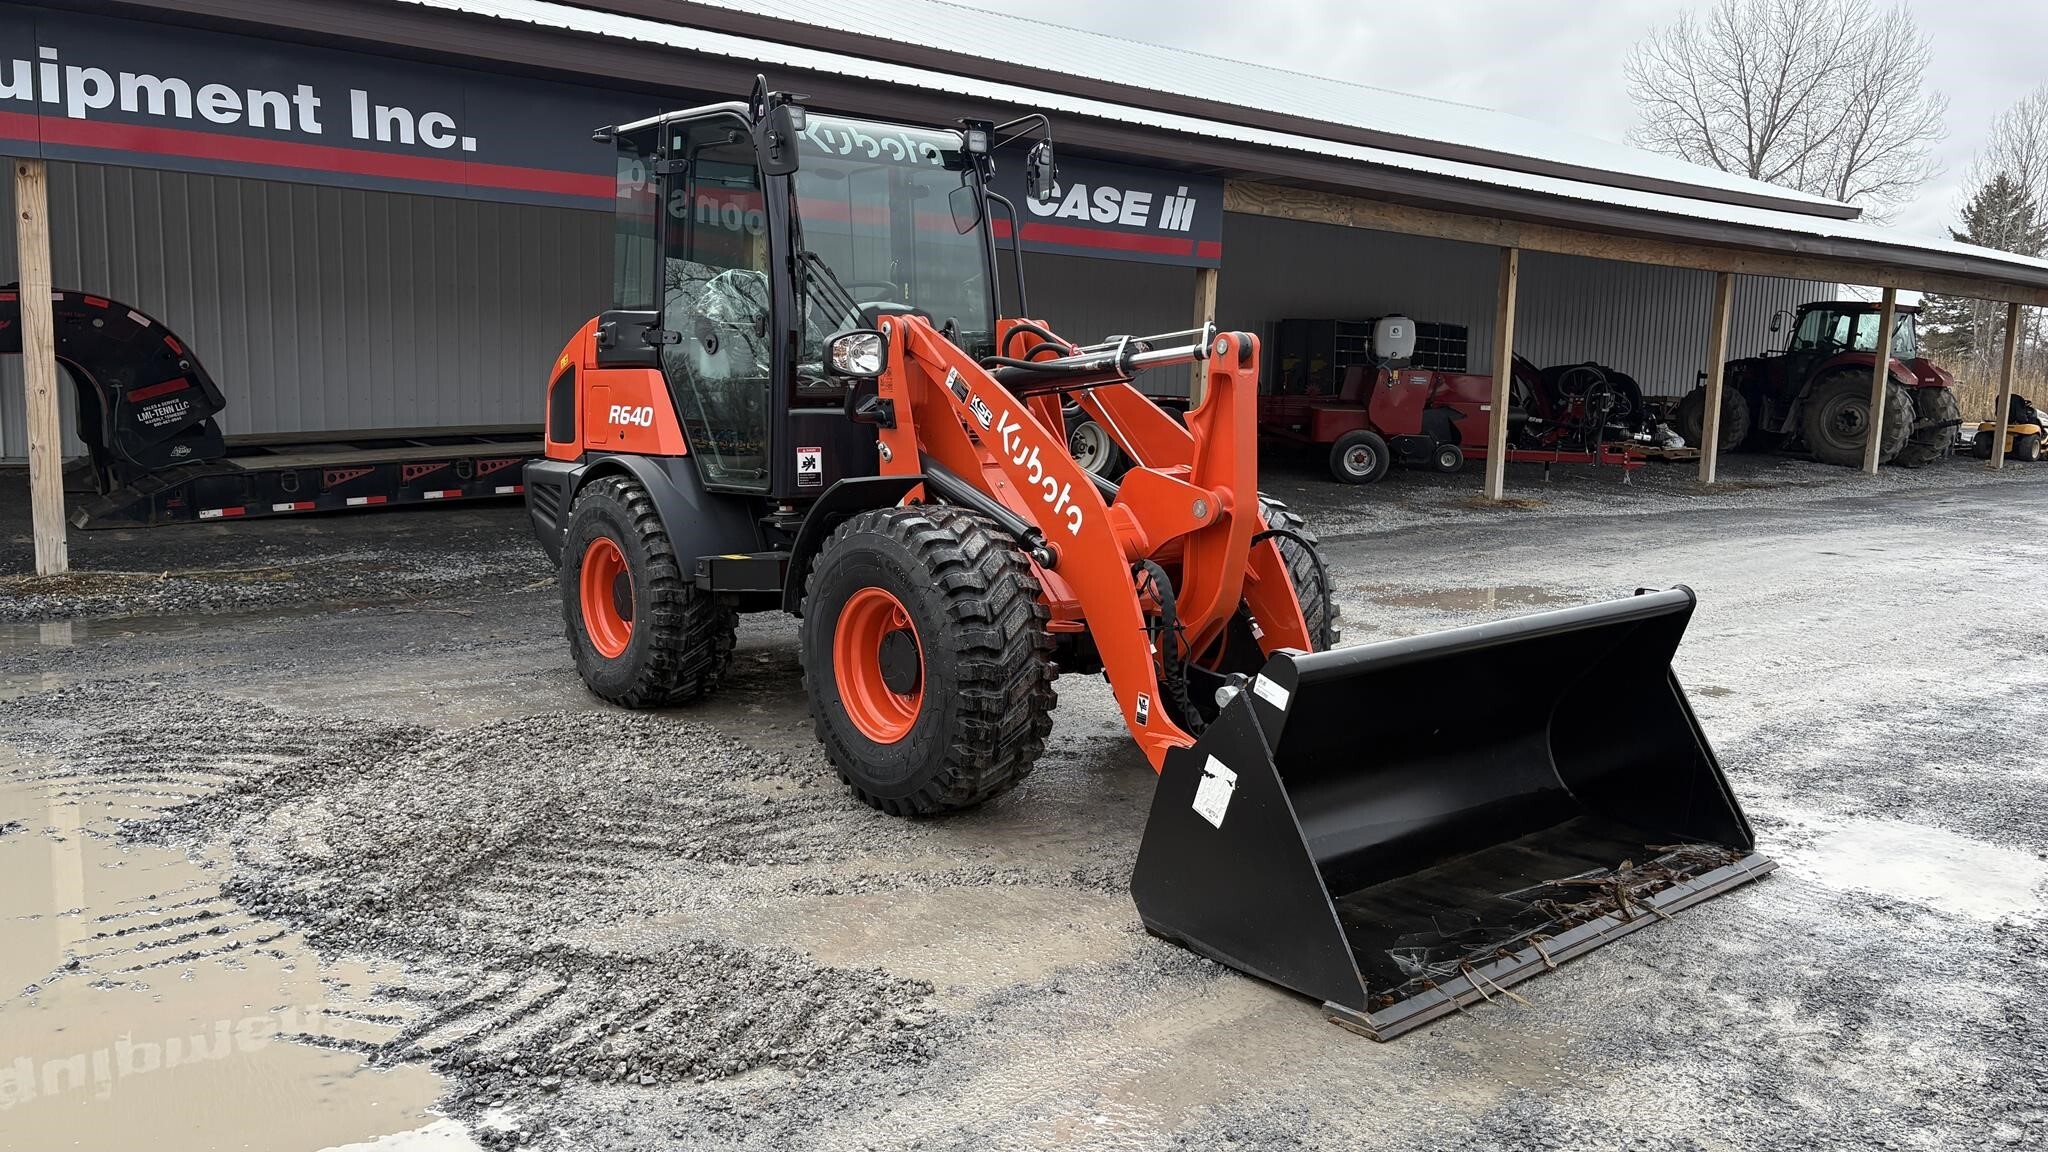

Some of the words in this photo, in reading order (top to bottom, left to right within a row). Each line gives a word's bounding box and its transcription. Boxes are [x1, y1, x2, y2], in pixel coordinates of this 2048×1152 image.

[0, 46, 322, 135] uipment
[350, 88, 478, 152] Inc.
[798, 120, 946, 167] Kubota
[137, 404, 175, 422] LMI-TENN
[175, 401, 190, 411] LLC
[608, 405, 654, 427] R640
[970, 393, 993, 423] KSR
[997, 409, 1084, 536] Kubota
